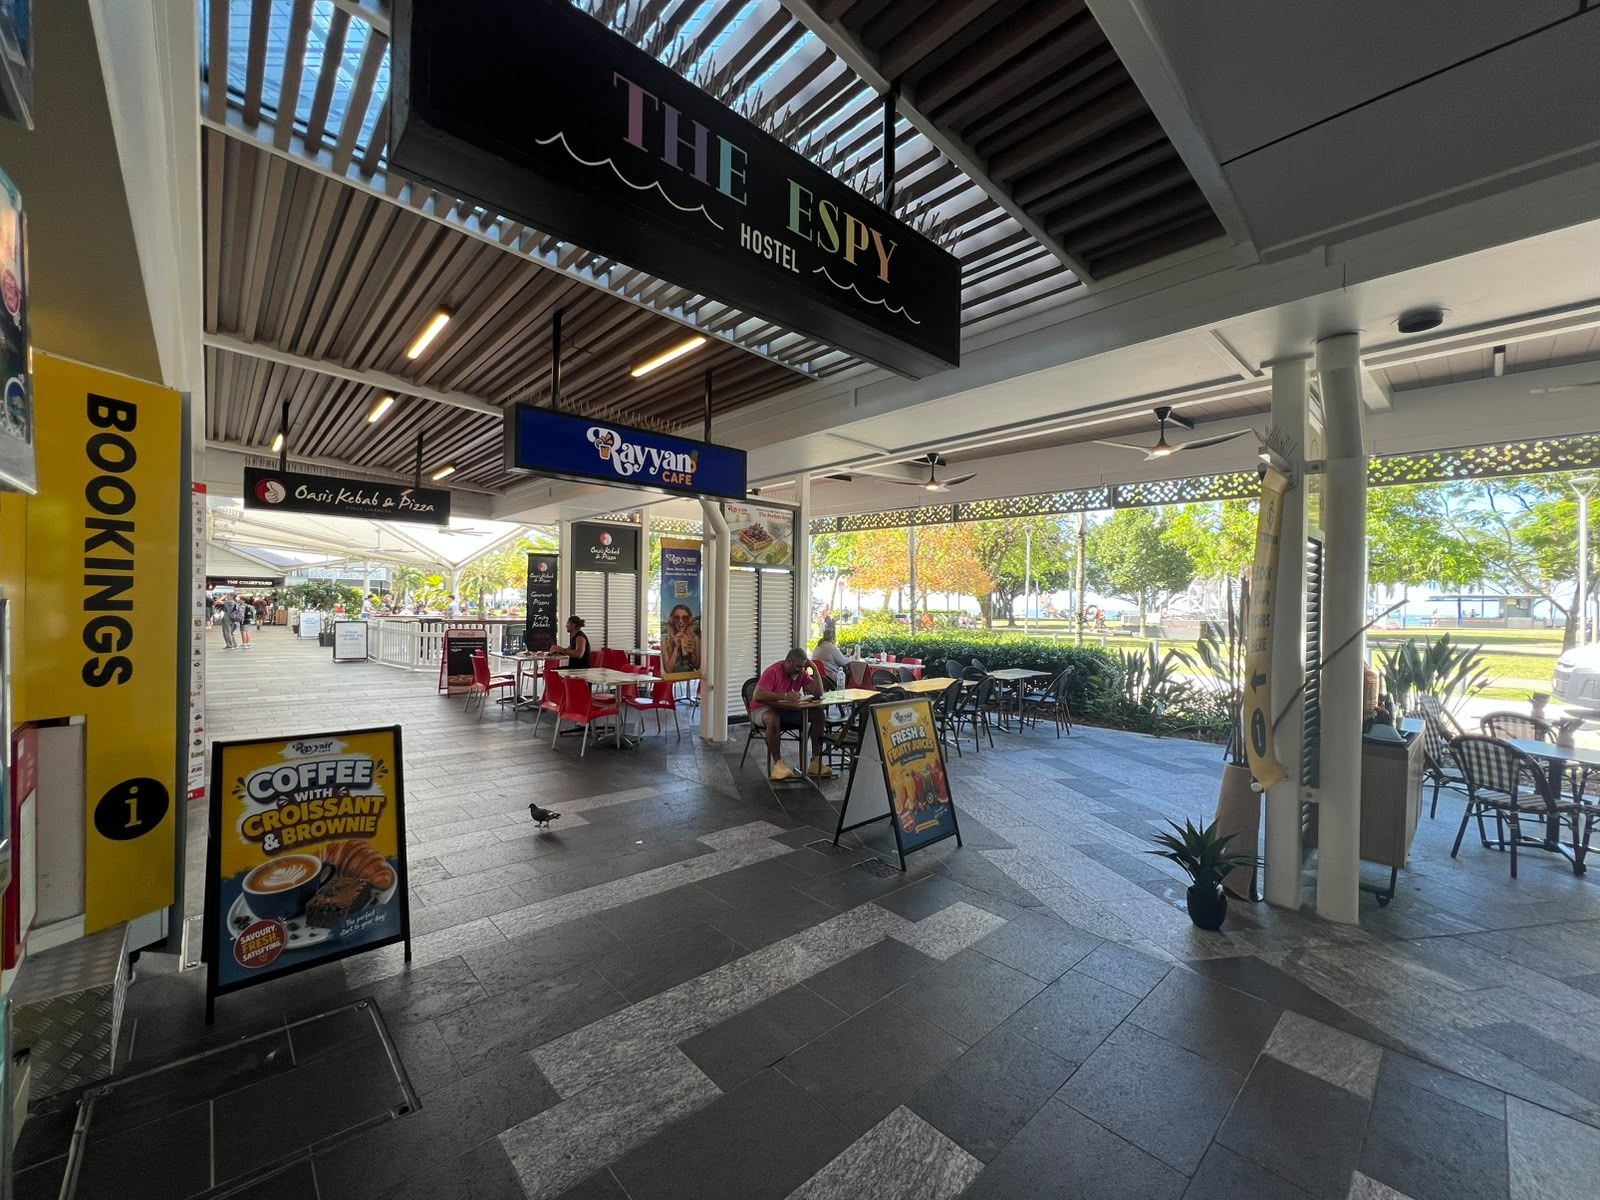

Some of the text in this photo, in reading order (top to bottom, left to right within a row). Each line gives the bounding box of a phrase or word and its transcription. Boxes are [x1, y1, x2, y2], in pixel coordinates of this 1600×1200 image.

[613, 71, 898, 285] THE ESPY
[740, 222, 800, 274] HOSTEL
[586, 426, 693, 477] Rayyan
[662, 471, 693, 486] CAFE
[294, 484, 435, 513] Oasis Kebab & Pizza
[82, 392, 138, 688] BOOKINGS
[530, 590, 553, 598] Gourmet
[533, 614, 550, 623] Tasty
[1251, 613, 1271, 628] TOURS
[1251, 637, 1267, 652] HERE
[292, 741, 333, 755] Rayyan
[890, 726, 926, 746] FRESH &
[248, 760, 373, 800] COFFEE
[294, 787, 333, 802] WITH
[242, 796, 385, 837] CROISSANT
[263, 815, 377, 851] & BROWNIE
